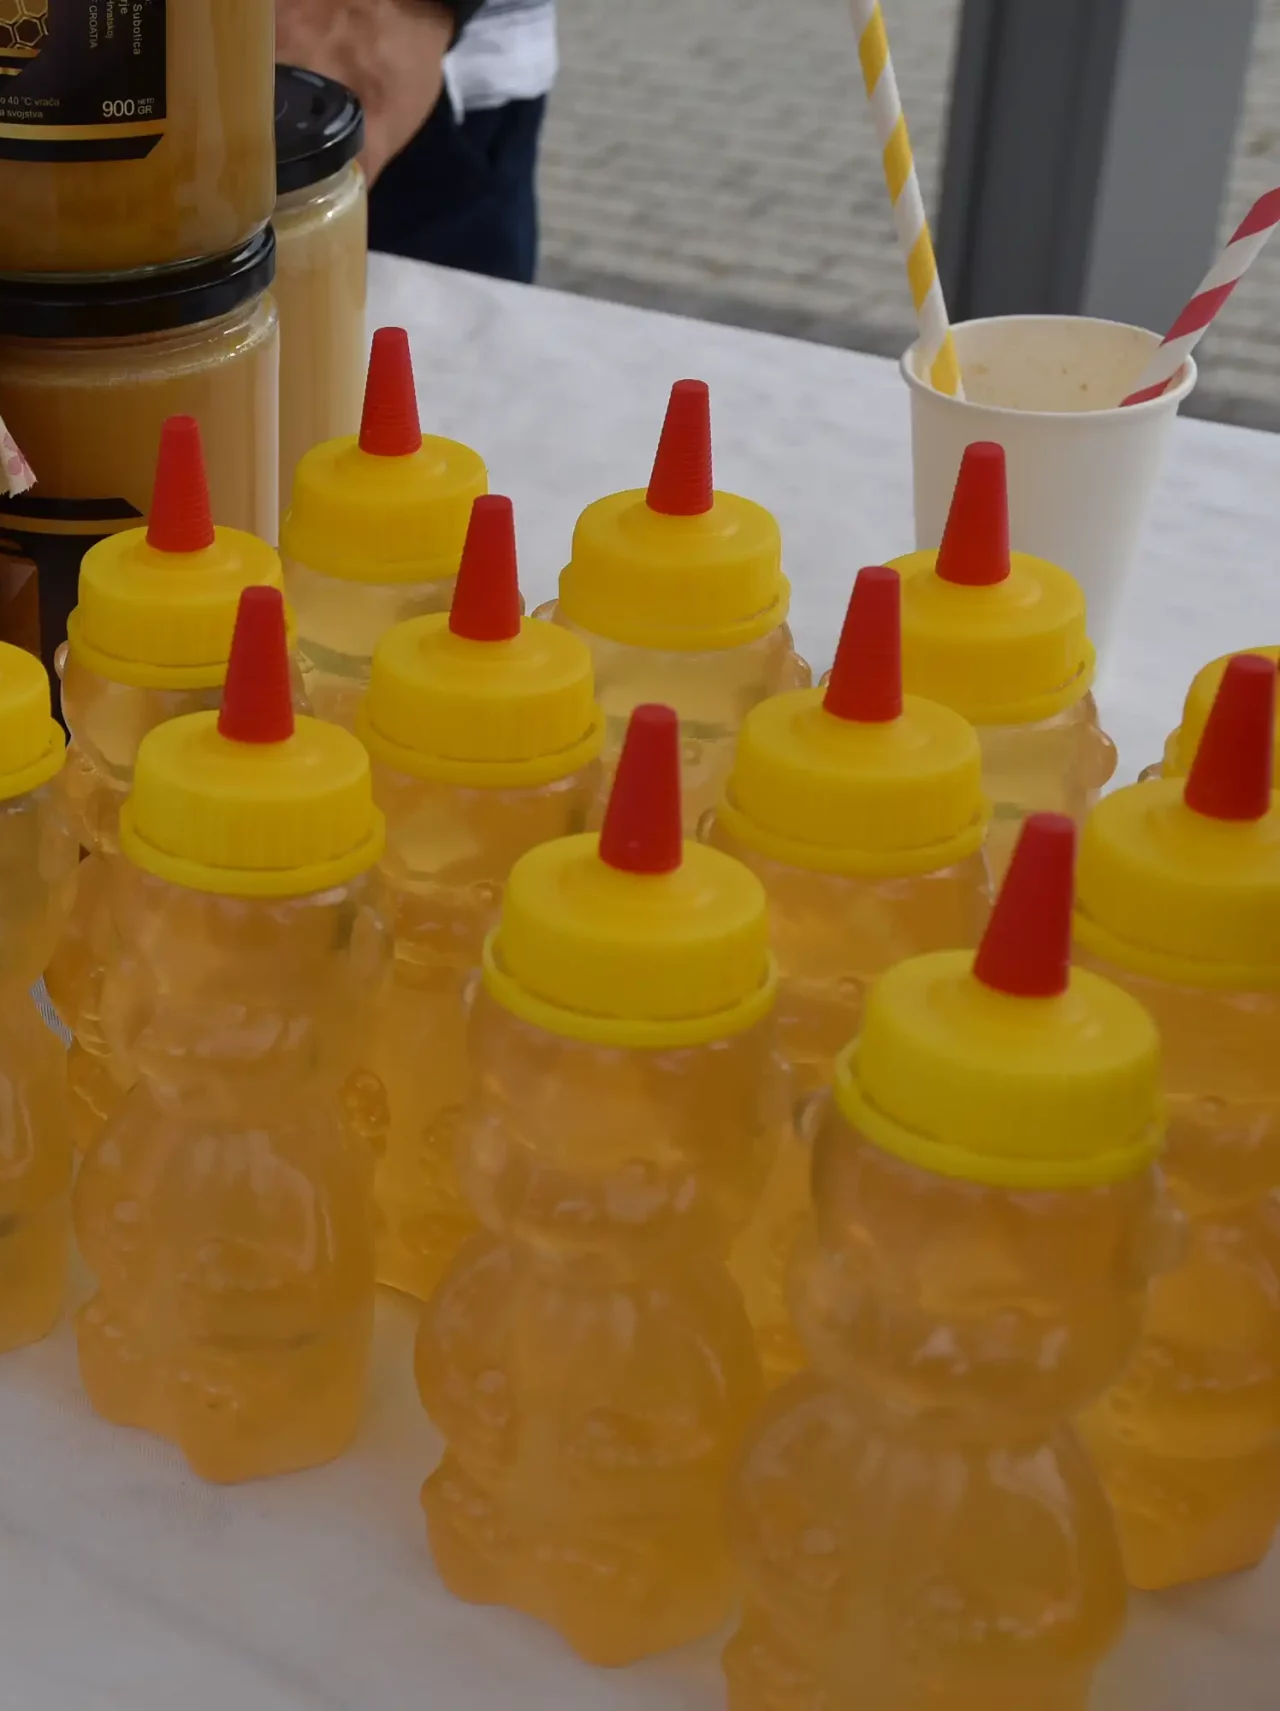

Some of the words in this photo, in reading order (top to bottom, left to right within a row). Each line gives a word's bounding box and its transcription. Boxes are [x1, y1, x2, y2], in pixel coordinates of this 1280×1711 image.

[88, 4, 99, 49] CROATIA
[132, 3, 143, 55] Subotica
[7, 95, 19, 105] 40
[6, 108, 44, 120] svojstva
[102, 99, 135, 118] 900
[137, 105, 153, 115] GR
